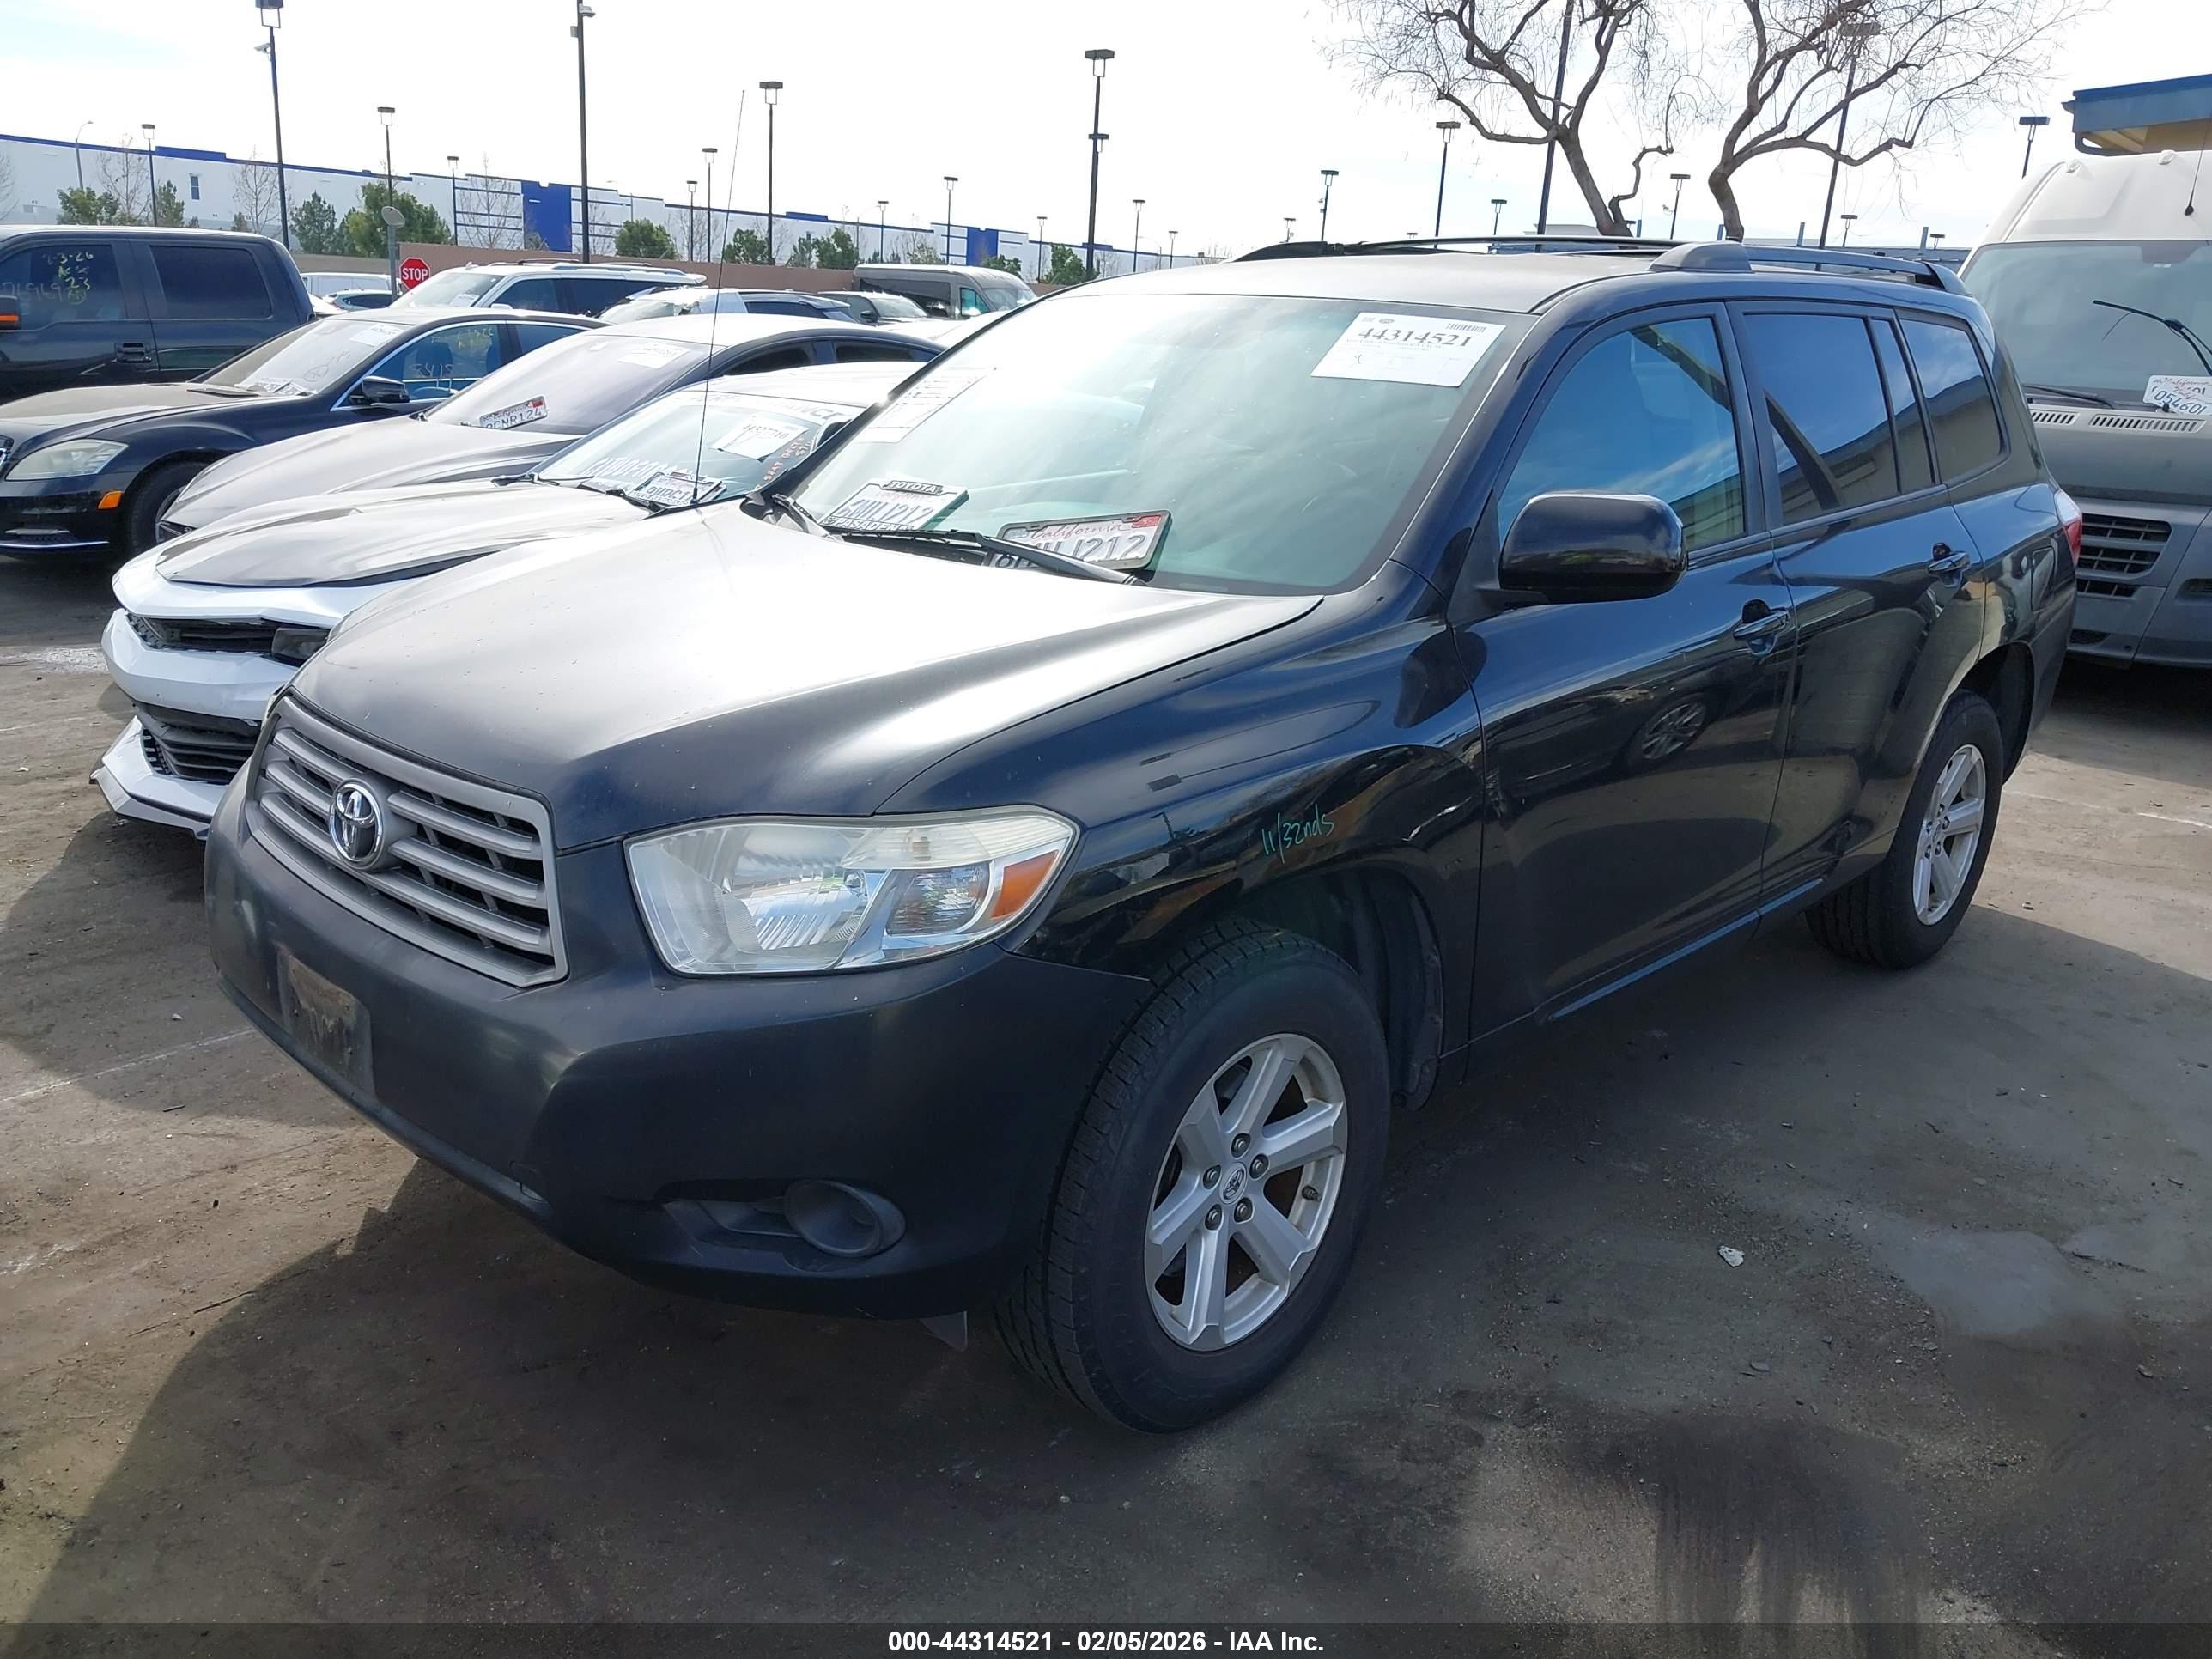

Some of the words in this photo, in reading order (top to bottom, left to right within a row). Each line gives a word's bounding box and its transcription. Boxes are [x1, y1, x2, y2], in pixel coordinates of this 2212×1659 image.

[402, 267, 428, 281] STOP
[1358, 327, 1473, 347] 44314521
[891, 481, 936, 493] TOYOTA
[1030, 522, 1127, 539] California
